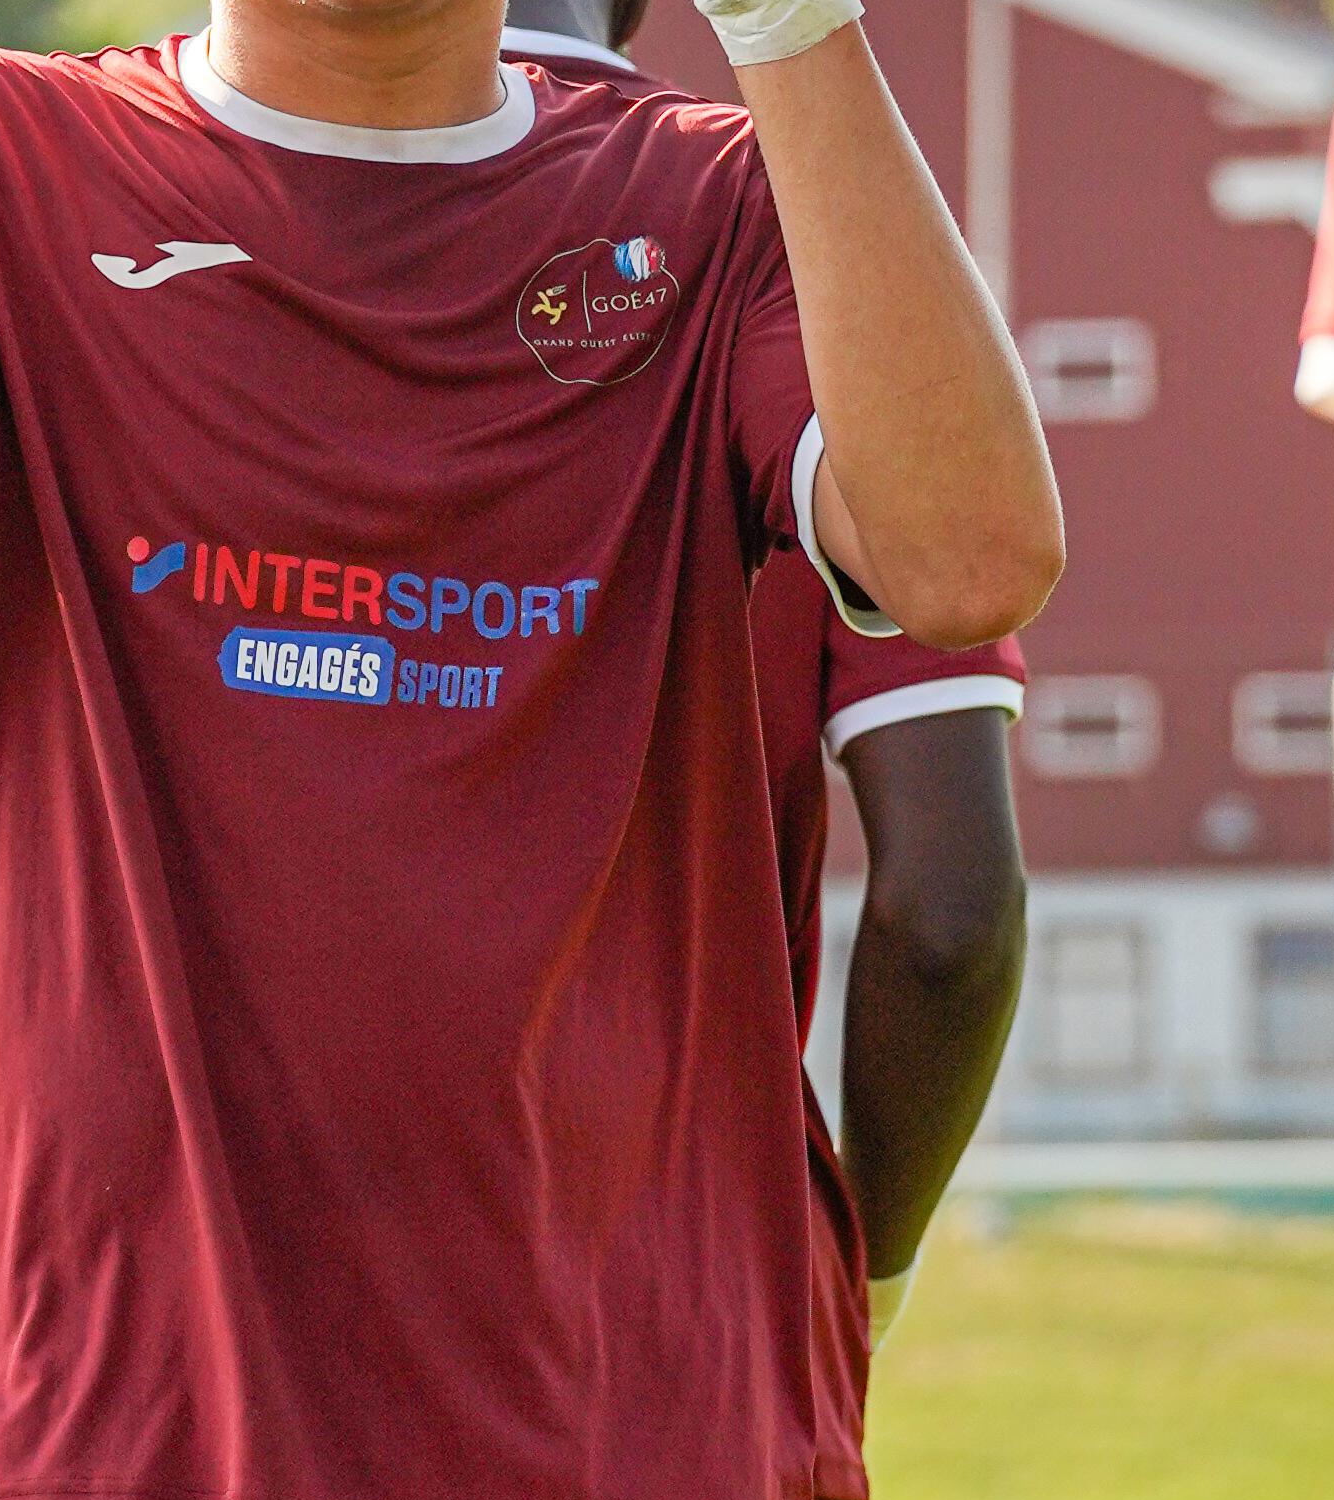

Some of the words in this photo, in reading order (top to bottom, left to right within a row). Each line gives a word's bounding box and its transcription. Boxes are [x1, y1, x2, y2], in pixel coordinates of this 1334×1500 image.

[533, 338, 574, 348] GRAND
[580, 338, 617, 349] OUEST
[193, 542, 599, 641] INTERSPORT
[236, 636, 382, 698] ENGAGÉS
[397, 658, 505, 710] SPORT
